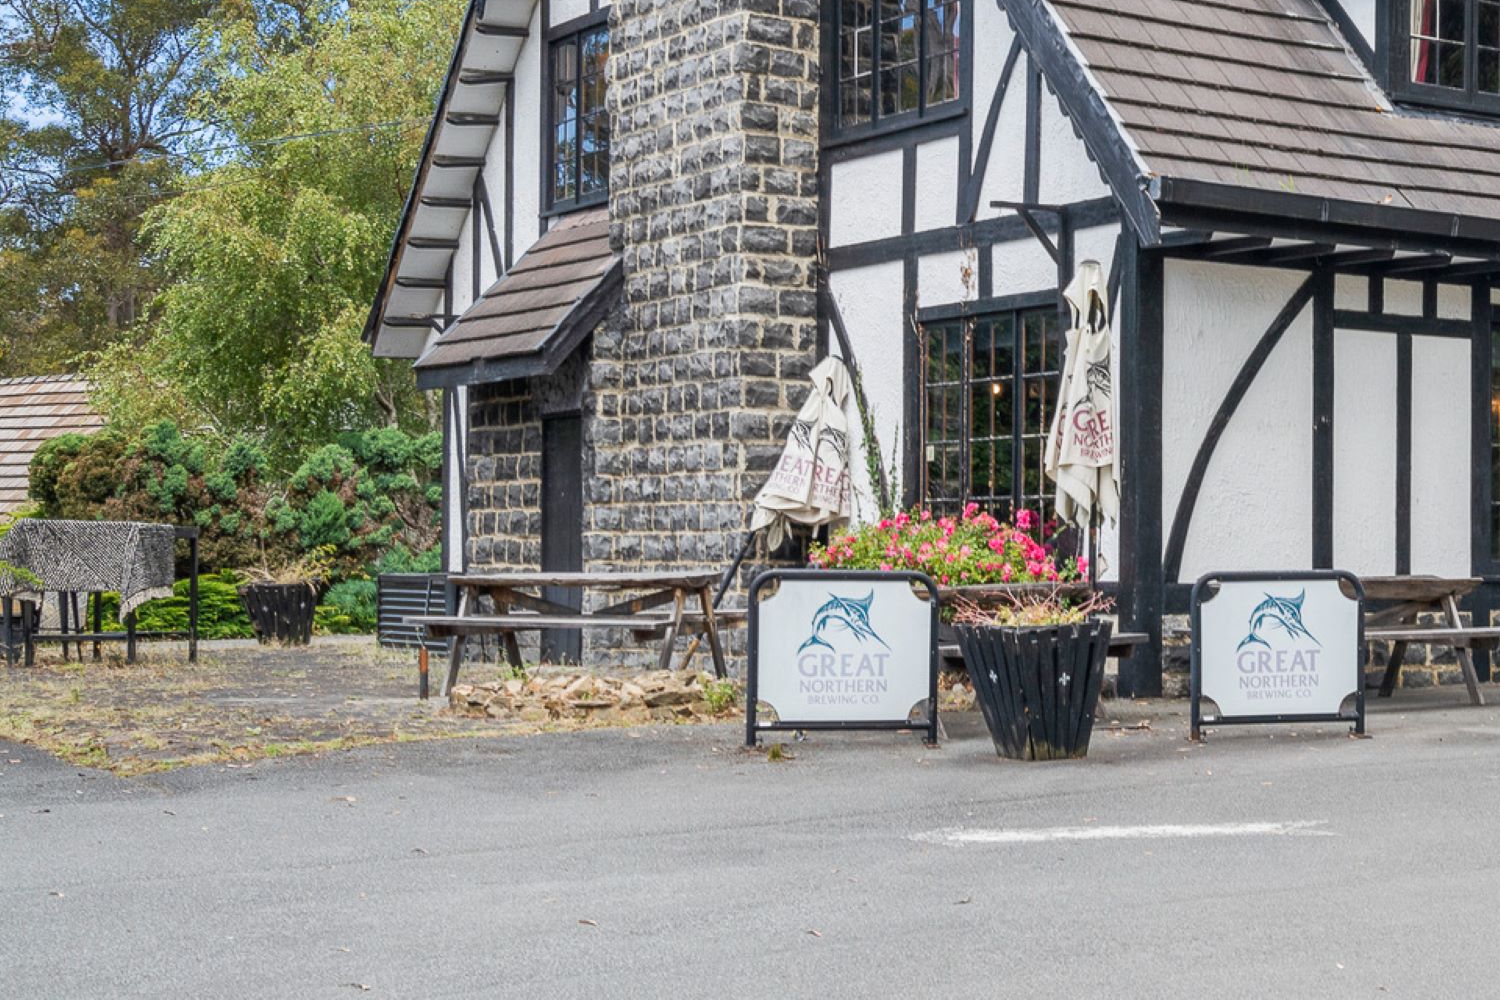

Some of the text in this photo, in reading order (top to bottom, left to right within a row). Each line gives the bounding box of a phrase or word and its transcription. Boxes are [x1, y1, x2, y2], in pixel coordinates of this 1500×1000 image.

[780, 455, 815, 477] EAT
[797, 653, 890, 678] GREAT
[1236, 649, 1321, 674] GREAT
[799, 679, 889, 693] NORTHERN
[1239, 674, 1320, 689] NORTHERN
[807, 694, 858, 705] BREWING
[1246, 690, 1292, 700] BREWING
